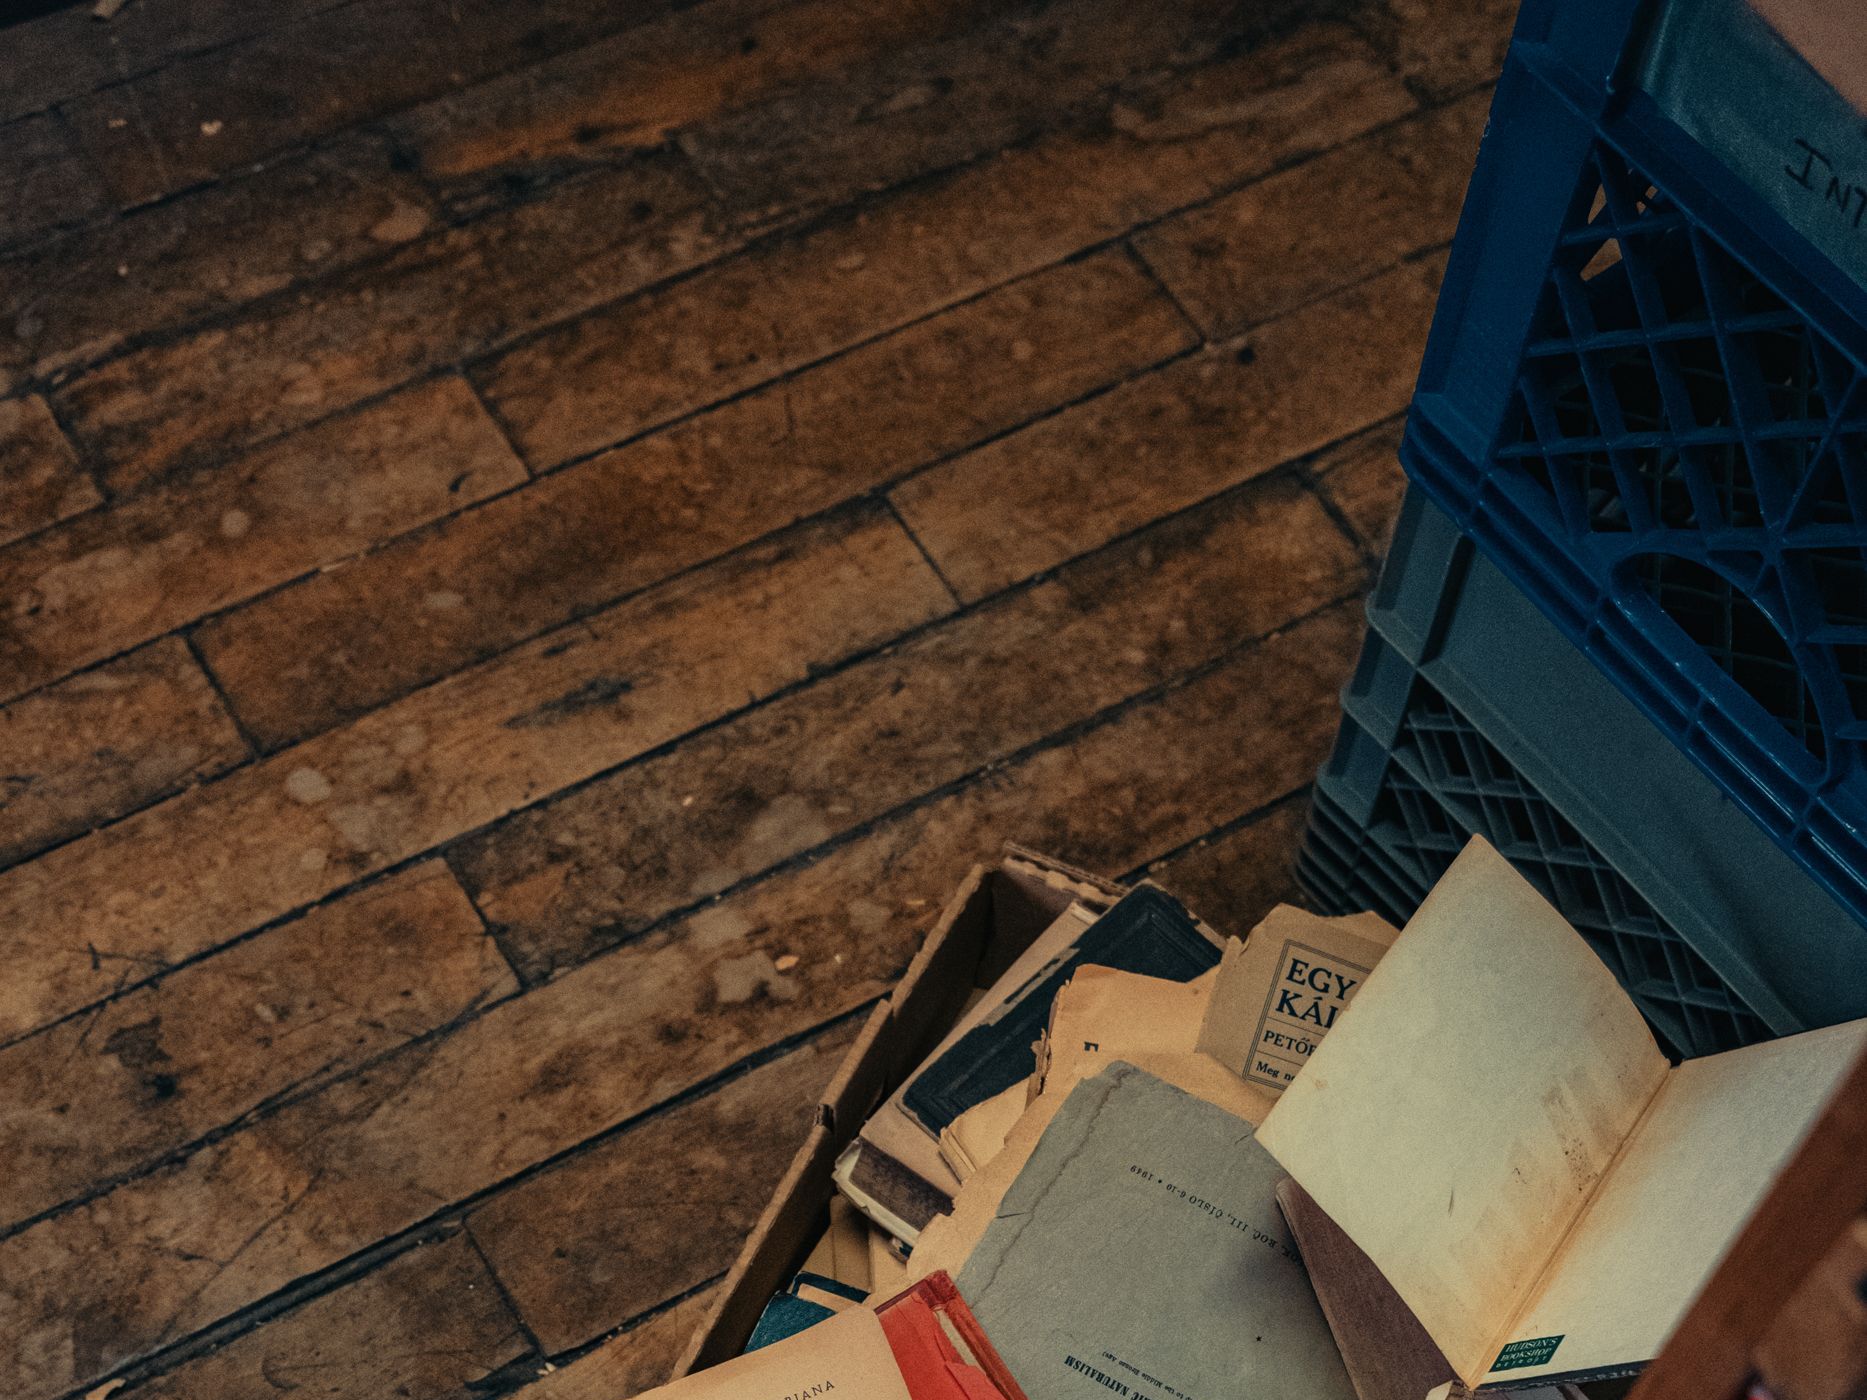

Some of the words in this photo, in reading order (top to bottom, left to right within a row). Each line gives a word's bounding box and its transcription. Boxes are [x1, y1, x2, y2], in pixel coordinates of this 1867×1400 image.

[1285, 957, 1357, 1000] EGY
[1255, 1060, 1279, 1078] Meg
[1129, 1164, 1153, 1180] 1949
[1165, 1183, 1186, 1198] 6-10
[1504, 1336, 1558, 1352] HUDSON'S
[1101, 1351, 1117, 1361] Age)
[1500, 1347, 1552, 1361] BOOKSHOP
[1064, 1355, 1129, 1396] NATURALISM
[1141, 1372, 1163, 1388] Middle
[1164, 1385, 1174, 1394] the
[1175, 1391, 1183, 1399] to
